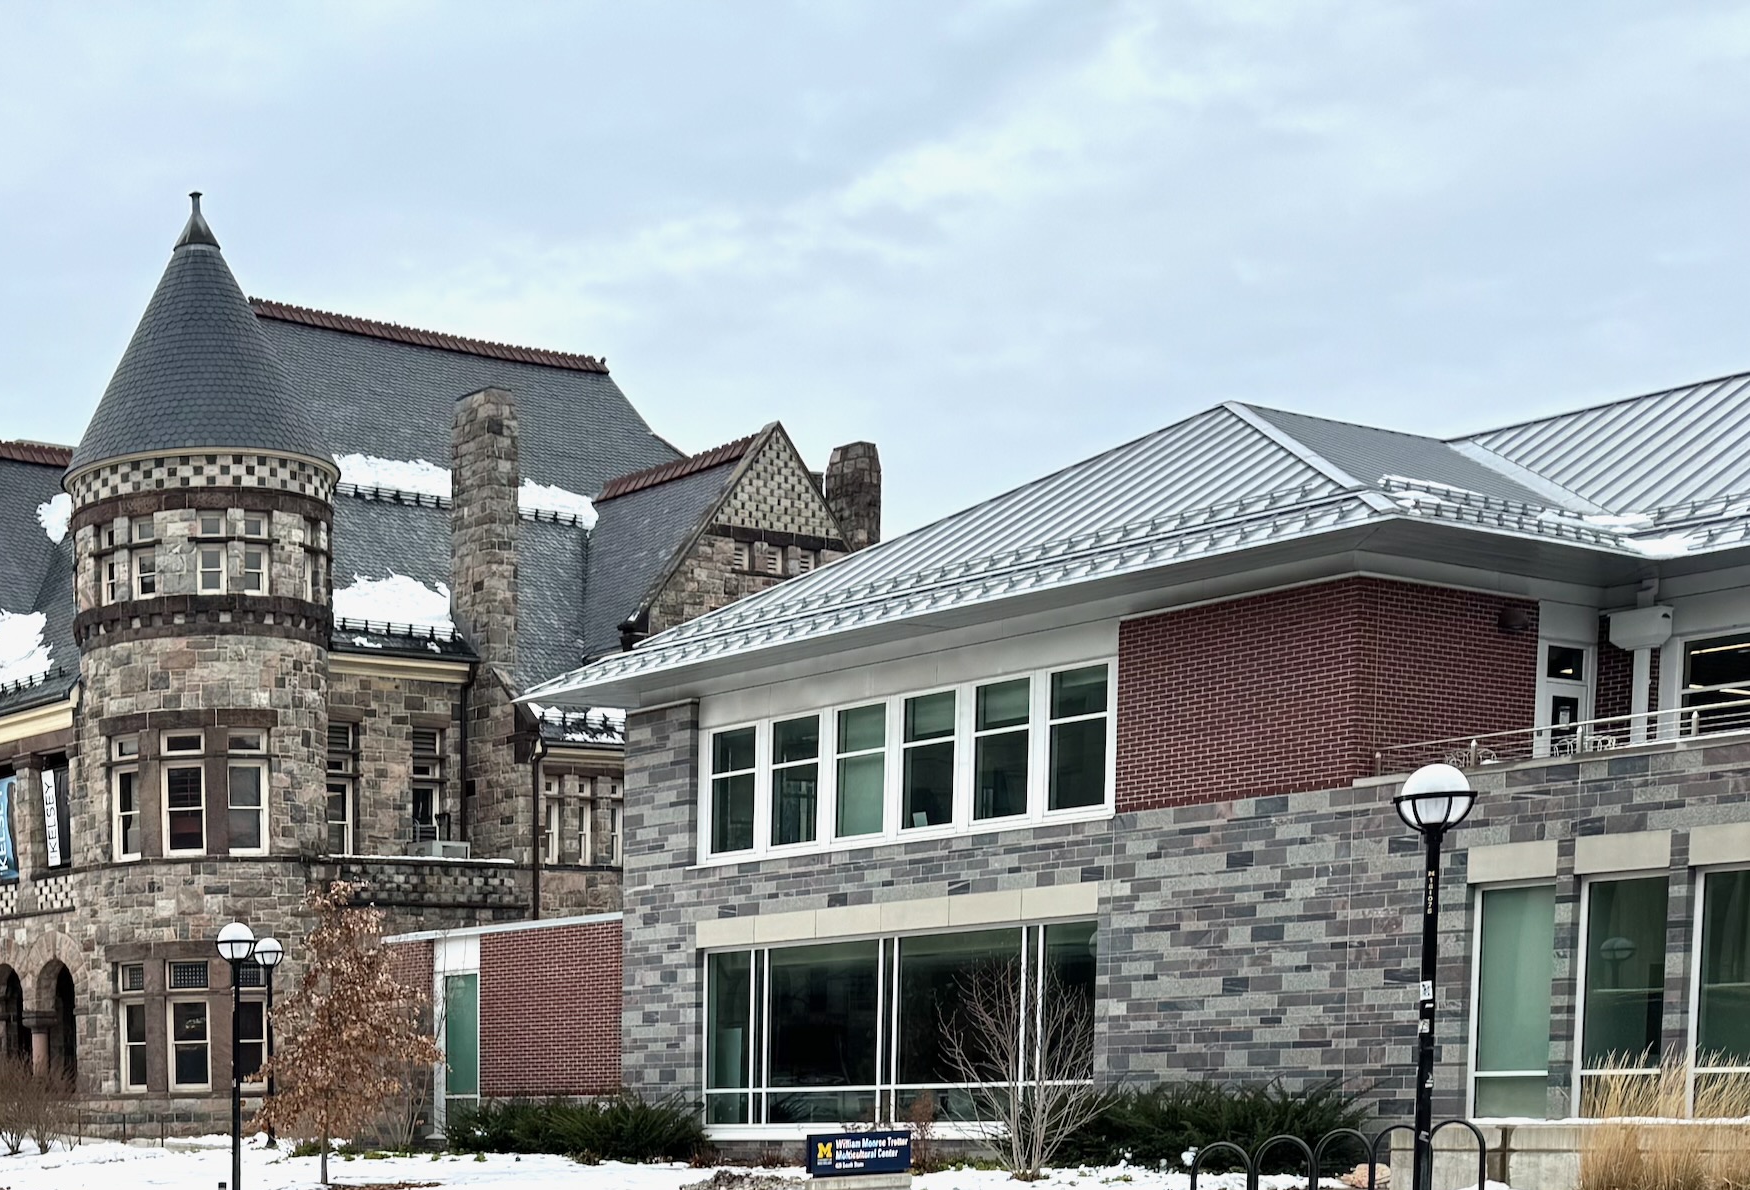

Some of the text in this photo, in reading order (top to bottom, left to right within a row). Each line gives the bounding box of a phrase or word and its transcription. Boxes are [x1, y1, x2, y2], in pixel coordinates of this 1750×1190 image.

[44, 781, 58, 854] KELSEY
[817, 1142, 833, 1159] M
[835, 1136, 909, 1150] William Monroe Trotter
[835, 1147, 899, 1160] Multicultural Center
